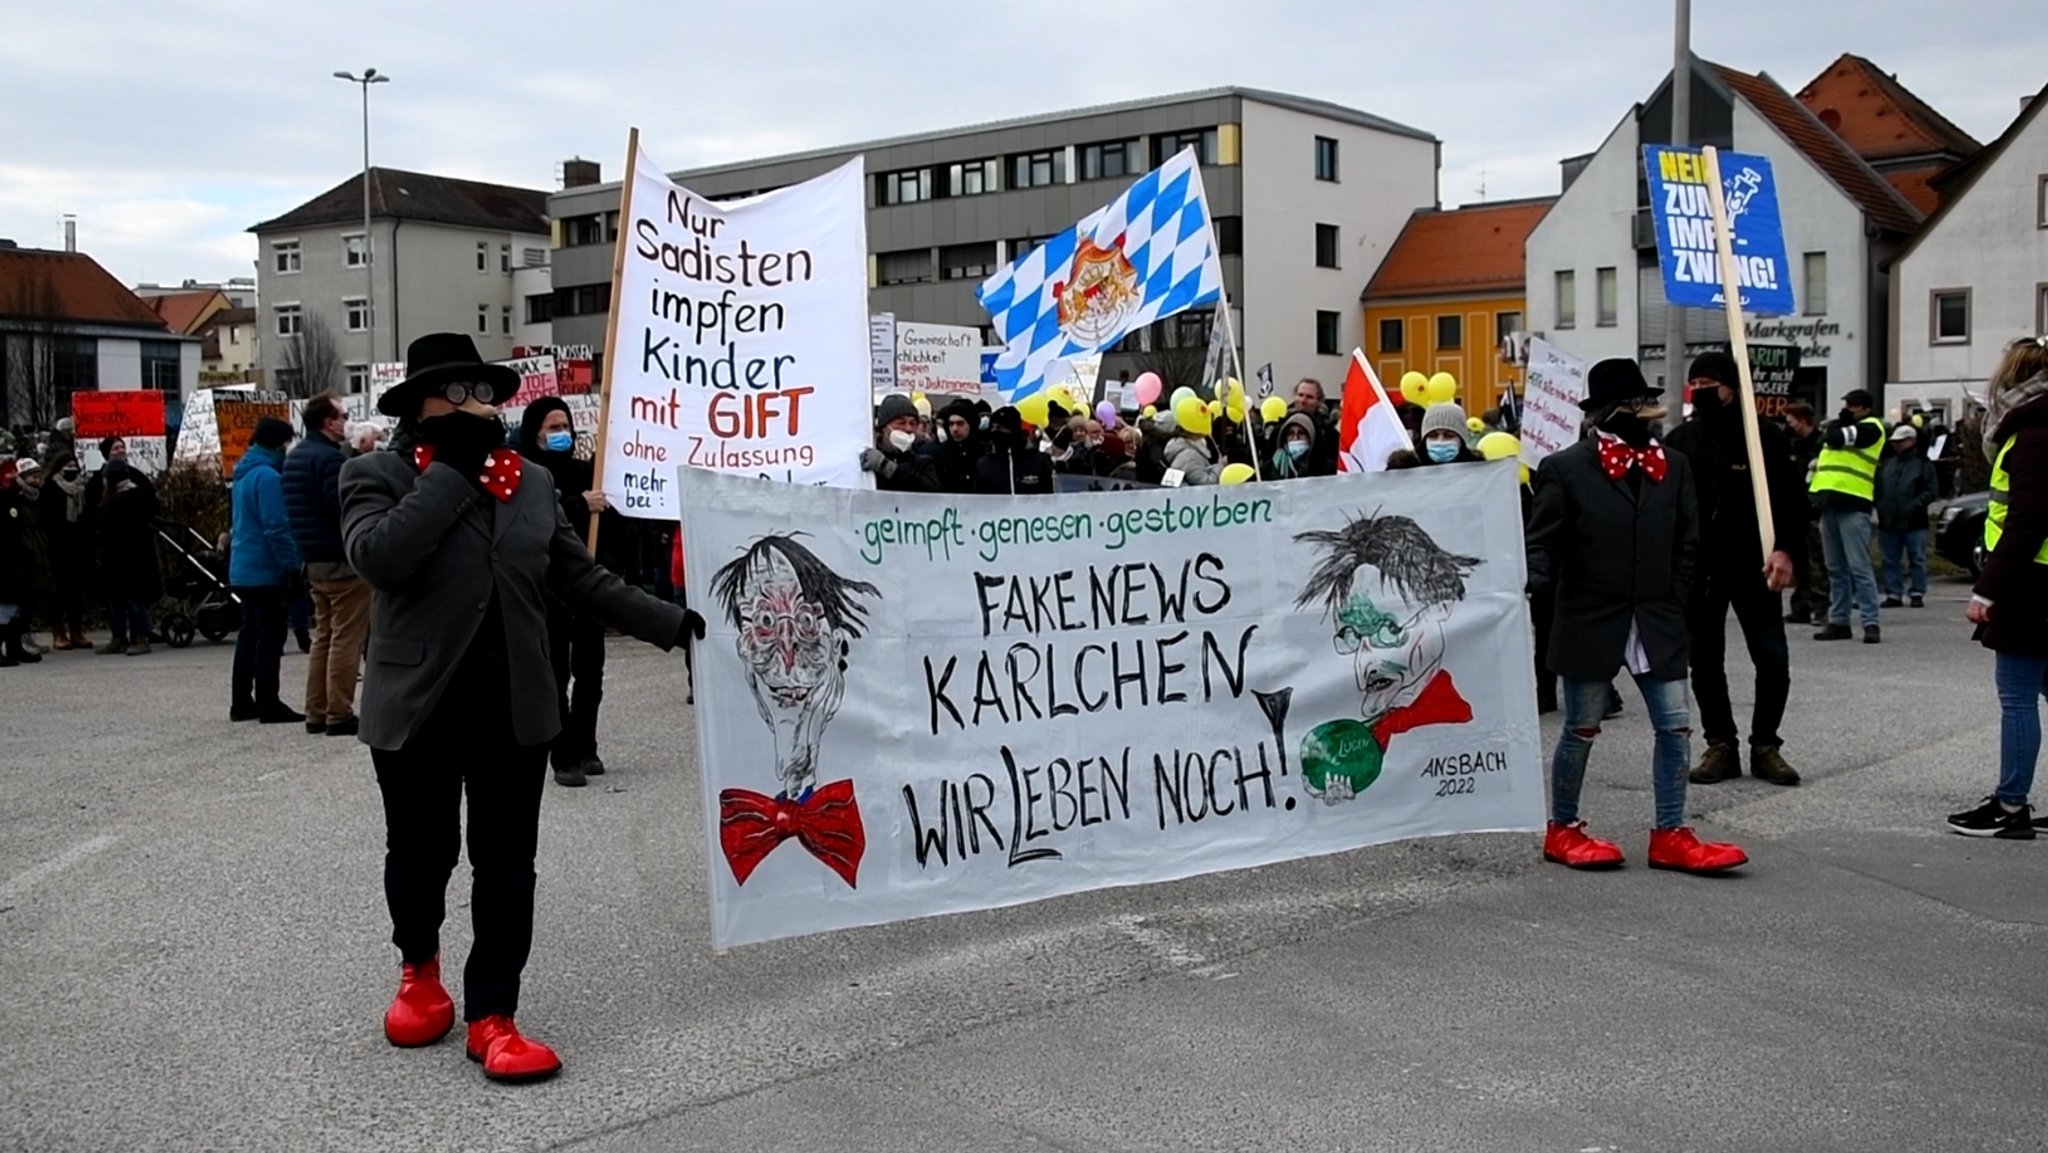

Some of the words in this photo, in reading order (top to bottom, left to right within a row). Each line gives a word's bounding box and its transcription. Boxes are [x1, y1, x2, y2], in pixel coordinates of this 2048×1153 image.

[667, 189, 725, 239] Nur
[636, 218, 812, 287] Sadisten
[652, 278, 784, 346] impfen
[1744, 319, 1840, 341] Markgrafen
[643, 327, 796, 390] Kinder
[897, 349, 946, 364] chlichkeit
[1748, 347, 1788, 367] ARUM
[631, 387, 681, 430] mit
[708, 386, 815, 440] GIFT
[623, 429, 667, 462] ohne
[688, 436, 814, 468] Zulassung
[624, 468, 668, 493] mehr
[923, 623, 1260, 736] KARLCHEN
[902, 772, 1005, 869] WIR
[1000, 745, 1131, 868] LEBEN
[1153, 686, 1298, 831] NOCH!
[1420, 750, 1508, 778] ANSBACH
[1434, 776, 1476, 798] 2022
